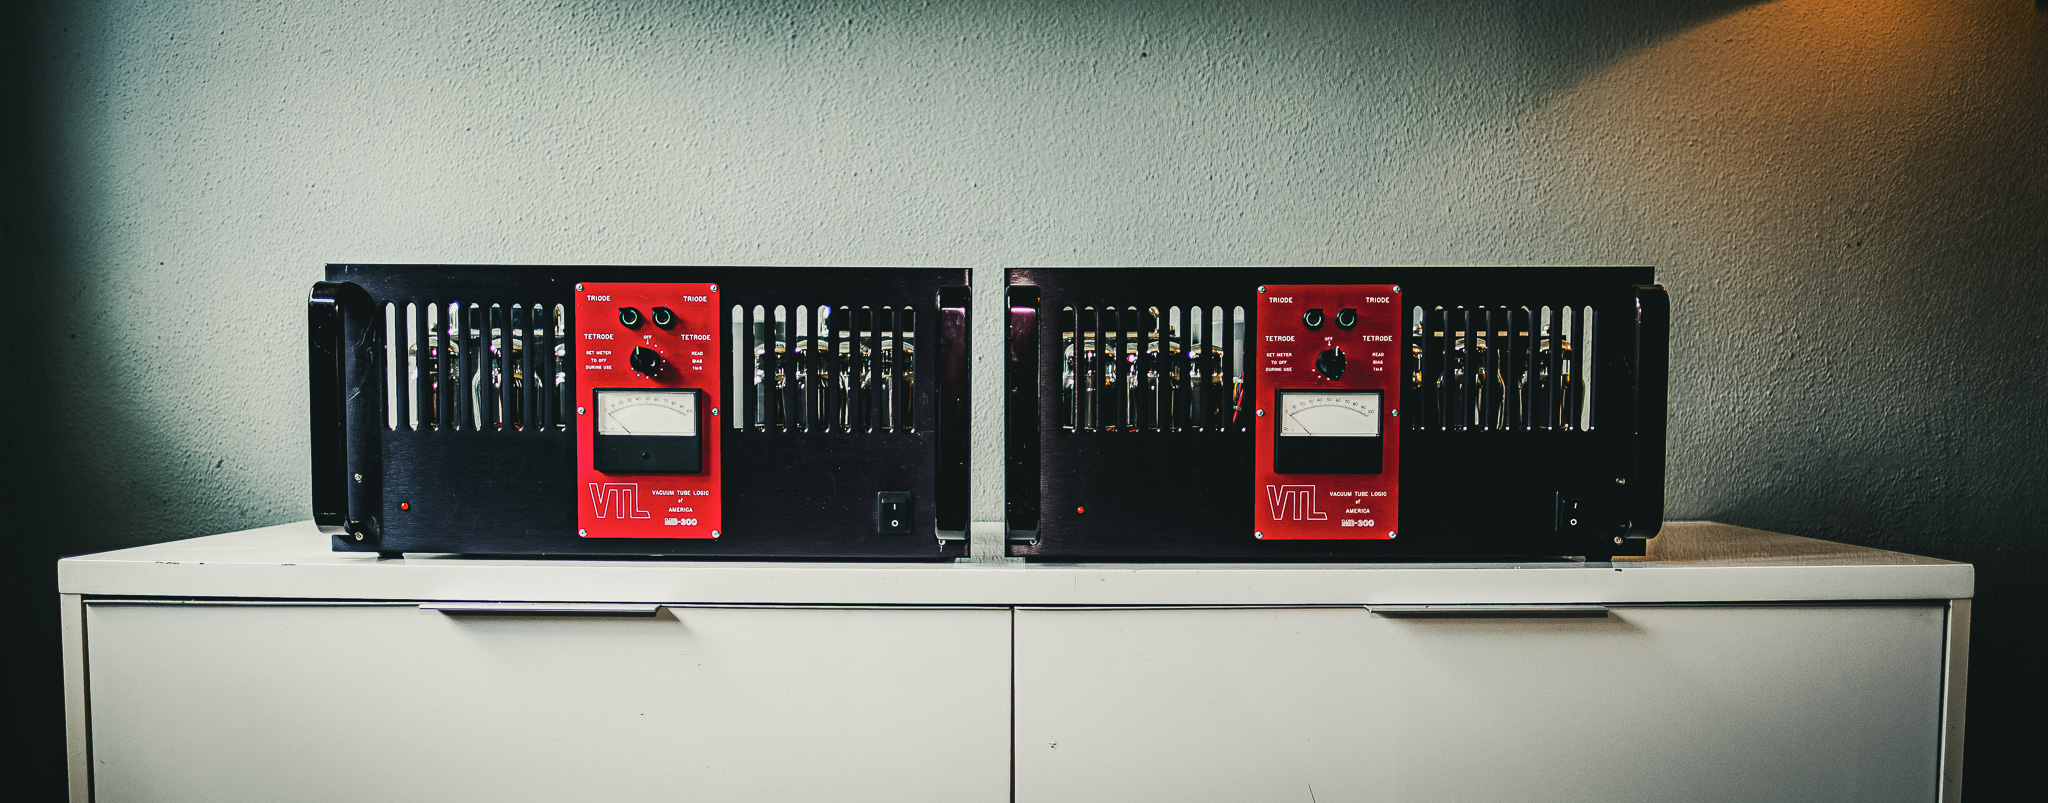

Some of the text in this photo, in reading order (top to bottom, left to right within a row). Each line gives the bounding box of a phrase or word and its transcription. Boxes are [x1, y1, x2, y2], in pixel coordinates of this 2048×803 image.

[586, 294, 611, 302] TRIODE
[682, 295, 708, 303] TRIODE
[1268, 296, 1293, 304] TRIODE
[1365, 296, 1390, 304] TRIODE
[680, 333, 712, 341] TETRODE
[588, 482, 652, 519] VTL
[1266, 484, 1328, 520] VTL
[664, 517, 698, 526] MB-300
[1341, 518, 1375, 527] MB-300
